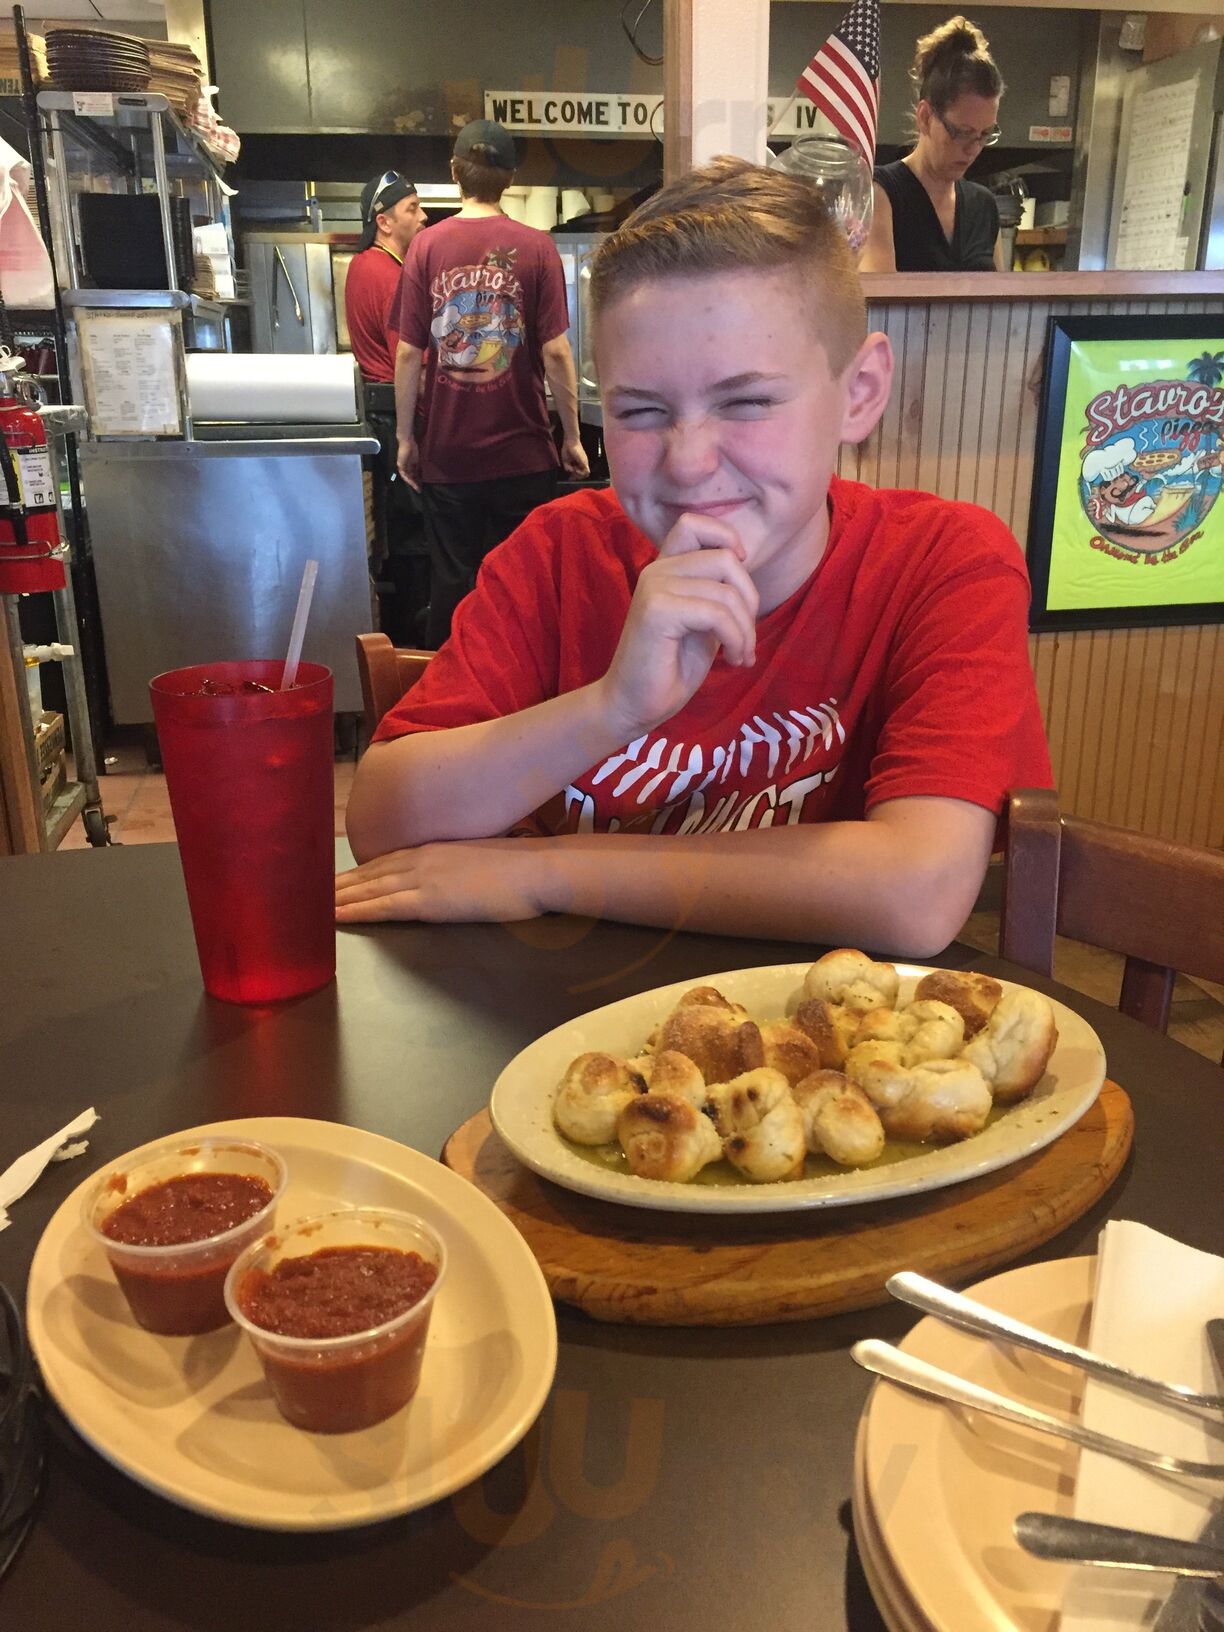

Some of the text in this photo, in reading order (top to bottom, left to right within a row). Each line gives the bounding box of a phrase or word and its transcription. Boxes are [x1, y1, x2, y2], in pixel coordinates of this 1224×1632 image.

[492, 99, 609, 126] WELCOME
[617, 102, 648, 126] TO
[796, 105, 818, 129] IV
